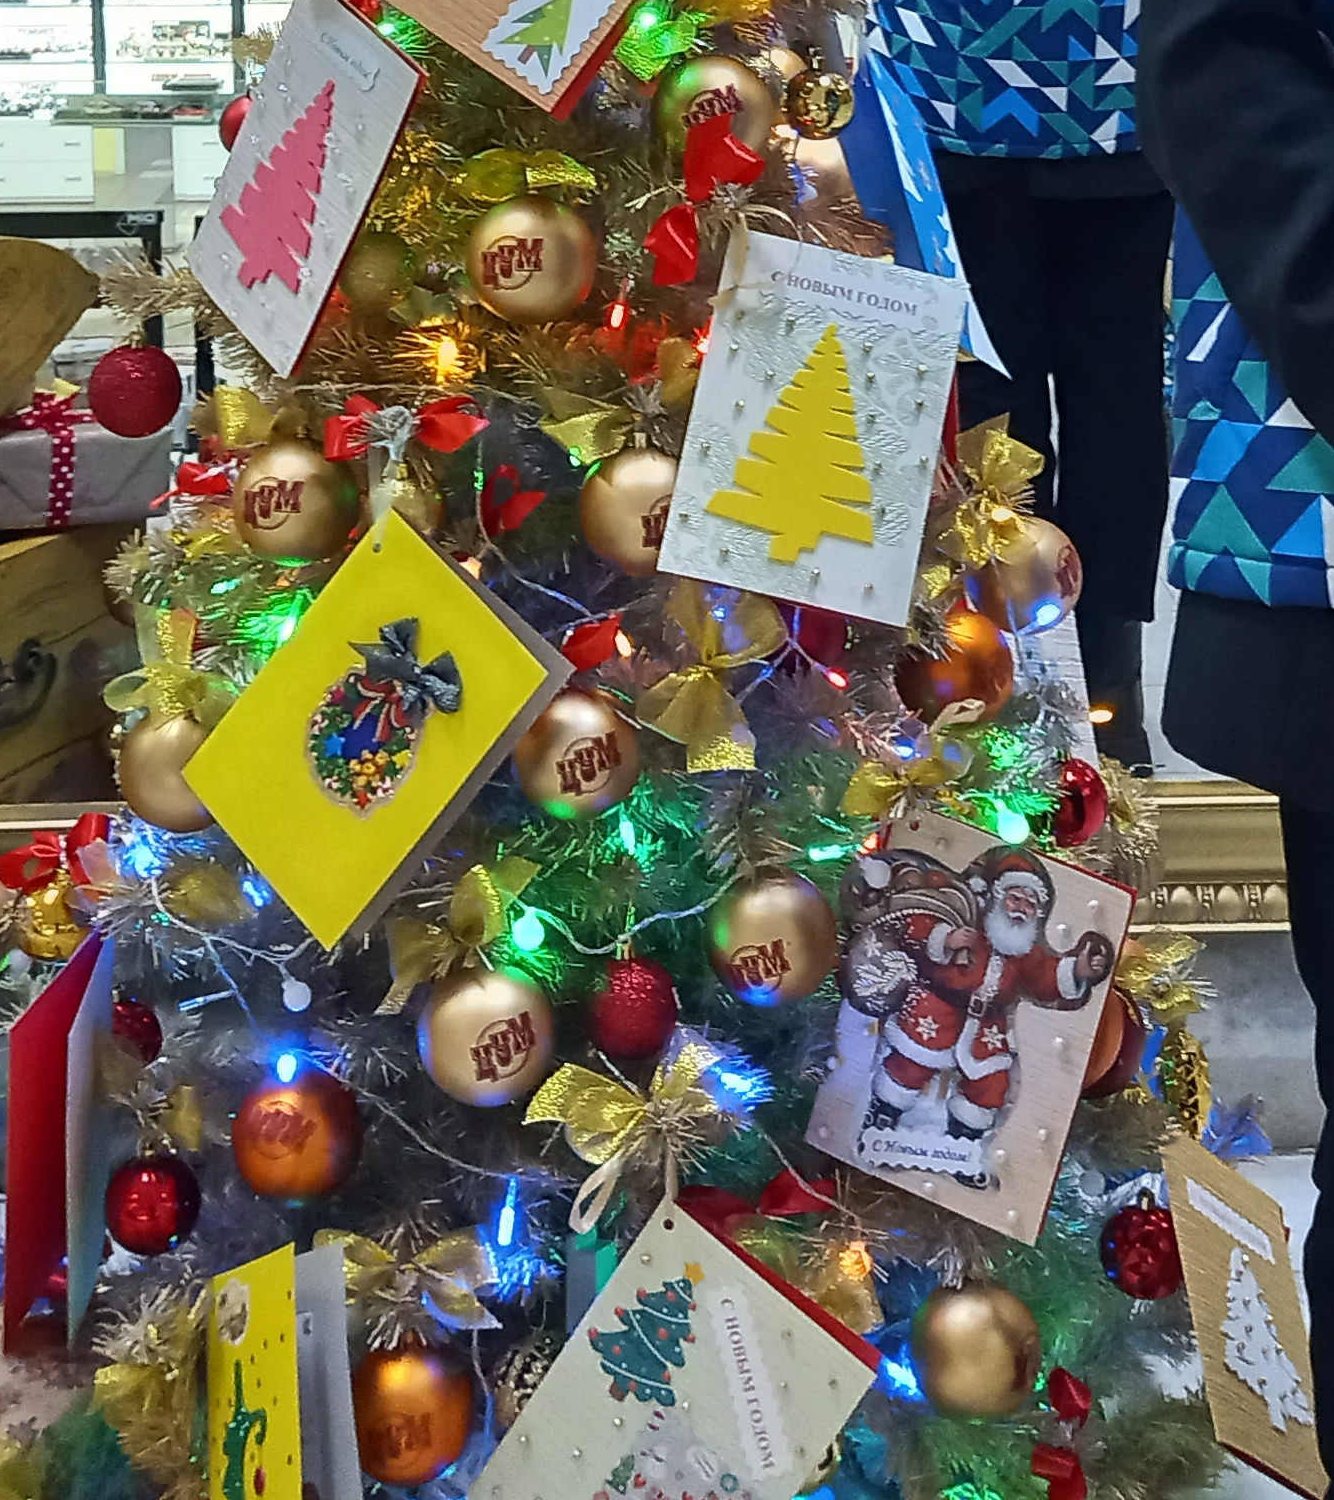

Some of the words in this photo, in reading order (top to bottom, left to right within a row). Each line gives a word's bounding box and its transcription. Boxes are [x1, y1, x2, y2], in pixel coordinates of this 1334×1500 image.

[481, 236, 544, 290] ЦУМ
[786, 274, 853, 301] НОВЫМ
[856, 291, 917, 316] ГОДОМ
[244, 479, 305, 529] ЦУМ
[555, 731, 622, 796] ЦУМ
[469, 1011, 536, 1082] ЦУМ
[725, 1316, 756, 1393] НОВЫМ
[747, 1398, 776, 1470] ГОДОМ
